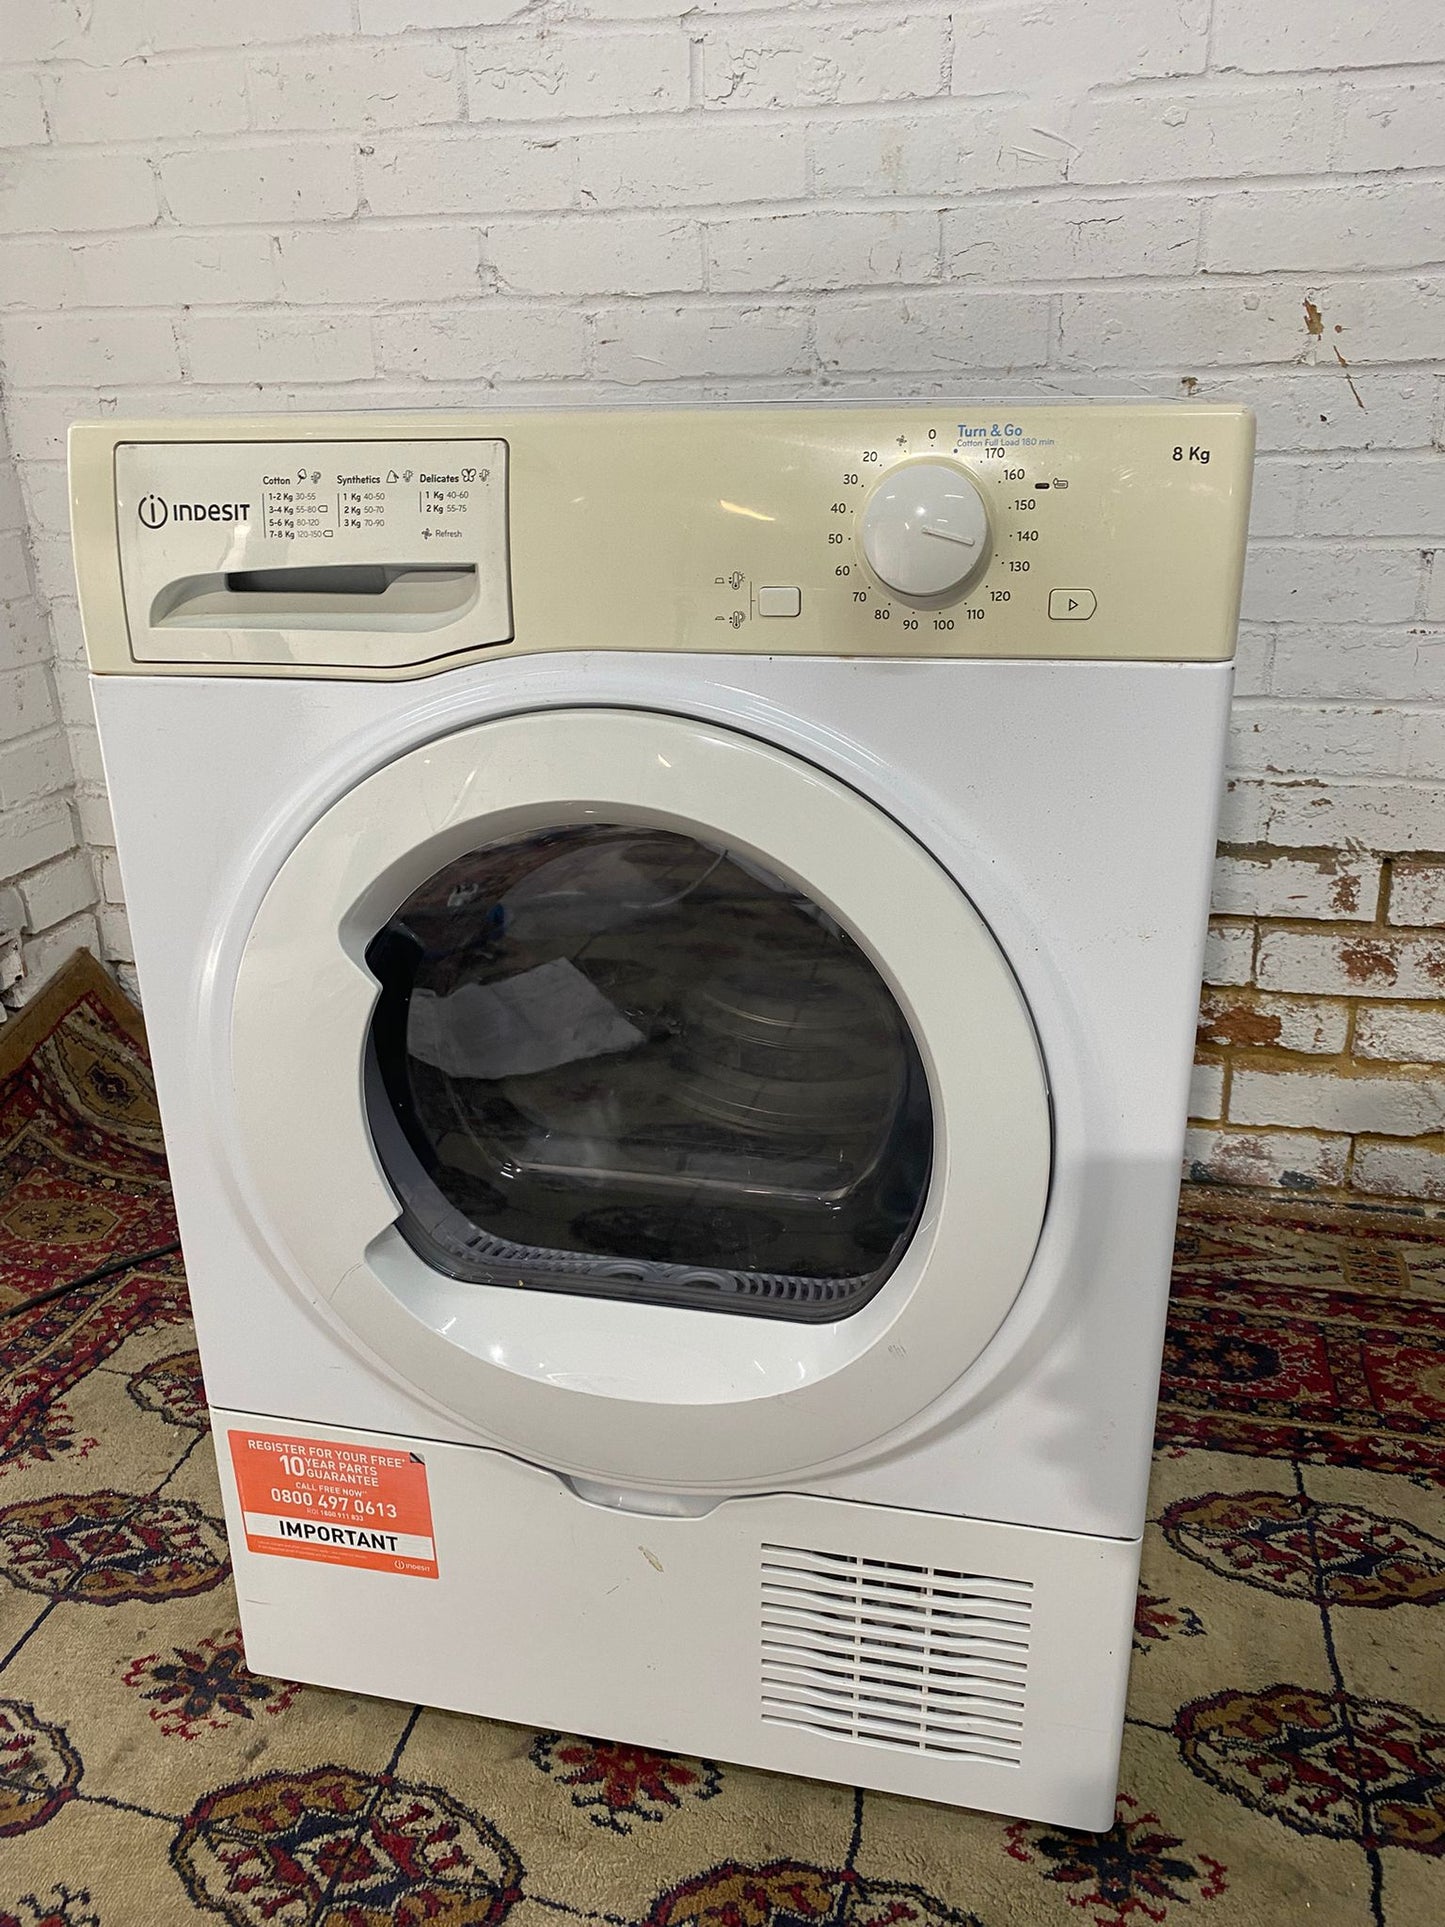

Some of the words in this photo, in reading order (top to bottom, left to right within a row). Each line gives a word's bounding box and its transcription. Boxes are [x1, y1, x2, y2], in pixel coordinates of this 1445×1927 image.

[928, 428, 937, 440] 0
[957, 425, 987, 438] Turn
[990, 425, 1001, 437] &
[1004, 424, 1023, 437] Go
[956, 438, 983, 447] Cotton
[985, 438, 999, 446] Full
[1001, 438, 1020, 446] Load
[1022, 438, 1037, 446] 180
[1039, 438, 1055, 446] min
[862, 451, 878, 462] 20
[985, 447, 1005, 459] 170
[1172, 446, 1183, 461] 8
[1189, 446, 1210, 464] Kg
[419, 473, 460, 483] Delicates
[843, 474, 858, 485] 30
[1003, 469, 1025, 480] 160
[262, 476, 291, 485] Cotton
[337, 475, 381, 486] Synthetics
[268, 493, 282, 501] 1-2
[283, 493, 293, 502] Kg
[351, 493, 361, 502] Kg
[433, 491, 444, 501] Kg
[446, 491, 469, 499] 40-60
[268, 506, 282, 514] 3-4
[284, 506, 294, 515] Kg
[296, 506, 317, 514] 55-80
[344, 506, 349, 514] 2
[351, 506, 361, 515] Kg
[363, 506, 385, 514] 50-70
[426, 504, 432, 513] 2
[433, 504, 444, 514] Kg
[446, 504, 467, 512] 55-75
[830, 503, 846, 513] 40
[1014, 500, 1036, 511] 150
[269, 519, 283, 527] 5-6
[285, 519, 294, 528] Kg
[344, 519, 349, 527] 3
[351, 519, 361, 529] Kg
[364, 519, 385, 527] 70-90
[269, 531, 283, 539] 7-8
[285, 531, 295, 540] Kg
[435, 529, 462, 538] Refresh
[1017, 531, 1039, 541] 140
[828, 534, 843, 544] 50
[835, 565, 850, 576] 60
[1009, 561, 1030, 572] 130
[853, 592, 867, 602] 70
[990, 591, 1011, 602] 120
[874, 610, 890, 620] 80
[966, 609, 985, 620] 110
[903, 620, 919, 630] 90
[933, 620, 955, 630] 100
[248, 1440, 306, 1456] REGISTER
[308, 1446, 333, 1460] FOR
[335, 1450, 368, 1464] YOUR
[279, 1455, 305, 1477] 10
[304, 1457, 336, 1470] YEAR
[338, 1462, 378, 1477] PARTS
[306, 1469, 379, 1487] GUARANTEE
[295, 1482, 316, 1491] CALL
[319, 1485, 340, 1494] FREE
[270, 1488, 313, 1507] 0800
[317, 1496, 349, 1512] 497
[353, 1499, 398, 1519] 0613
[306, 1507, 319, 1515] ROI
[279, 1520, 398, 1551] IMPORTANT
